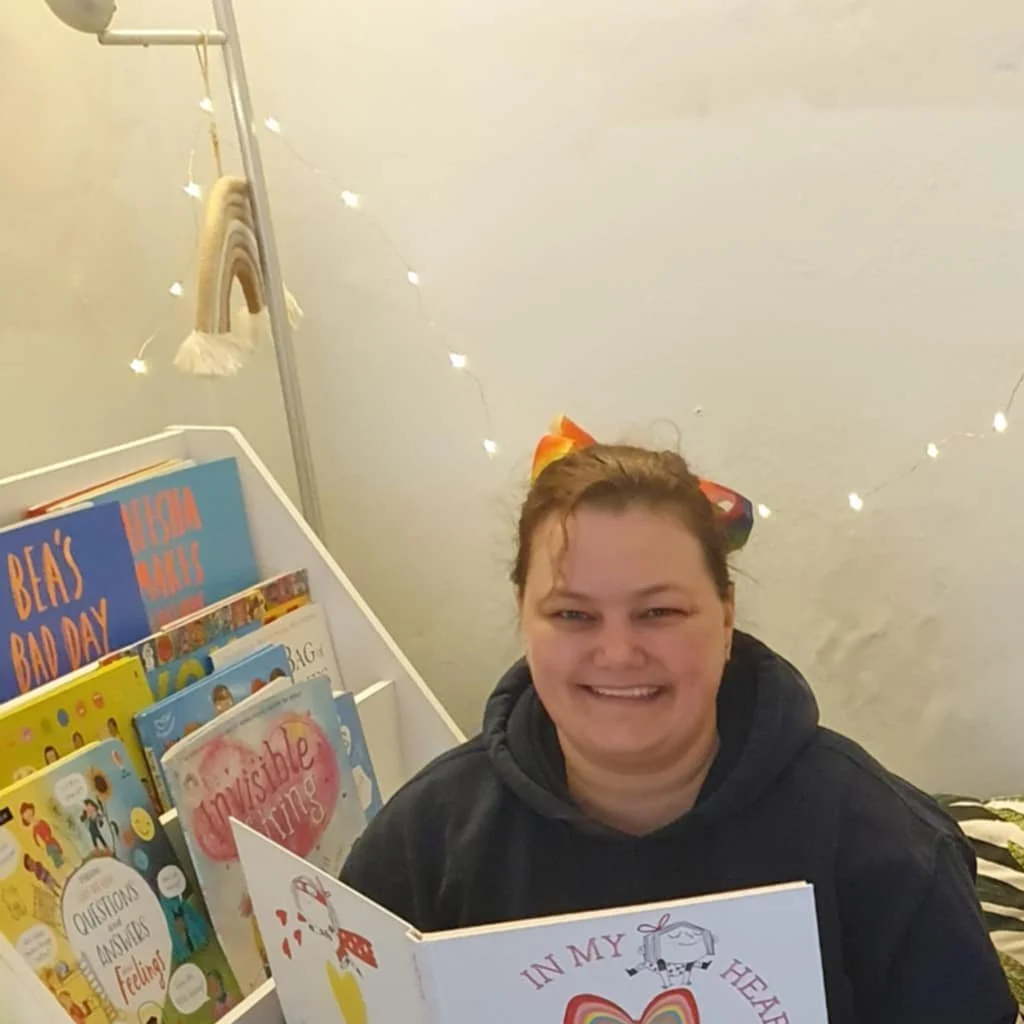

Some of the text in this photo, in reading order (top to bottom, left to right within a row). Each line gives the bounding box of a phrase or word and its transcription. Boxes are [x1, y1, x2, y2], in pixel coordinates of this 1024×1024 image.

[7, 528, 83, 621] BEA'S
[10, 624, 59, 694] BAD
[61, 597, 110, 671] DAY
[72, 883, 140, 936] QUESTIONS
[95, 915, 151, 966] ANSWERS
[520, 954, 565, 991] IN
[565, 933, 626, 969] MY
[114, 949, 166, 1005] Feelings
